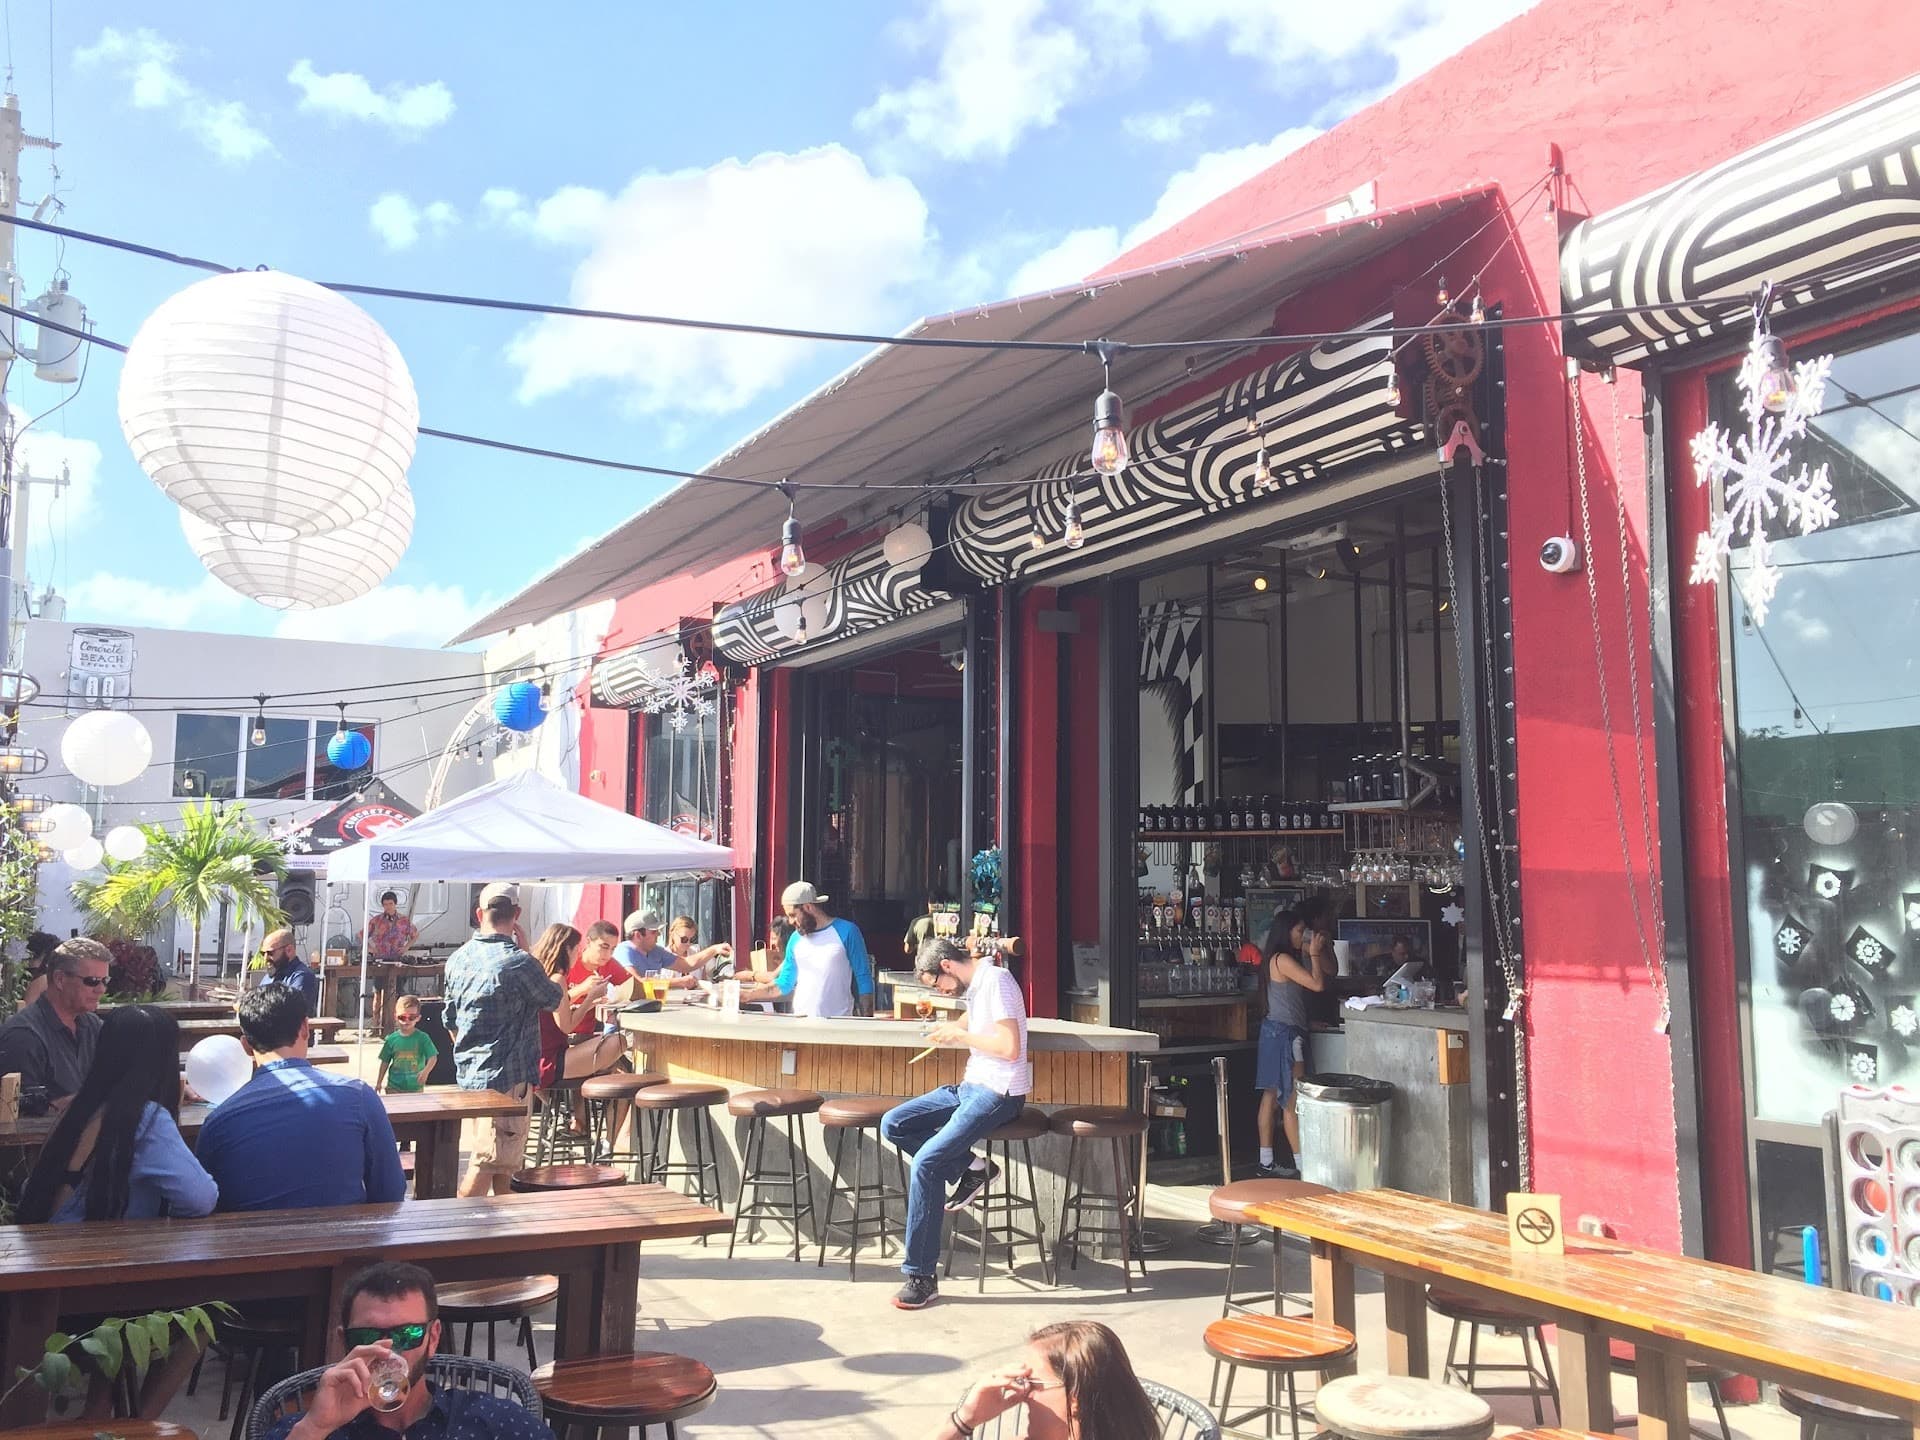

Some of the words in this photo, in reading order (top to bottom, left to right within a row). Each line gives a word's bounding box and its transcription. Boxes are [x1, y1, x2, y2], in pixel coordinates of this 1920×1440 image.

[80, 653, 123, 663] BEACH
[344, 808, 393, 828] CONCRETE
[380, 852, 409, 862] QUIK
[380, 862, 410, 870] SHADE
